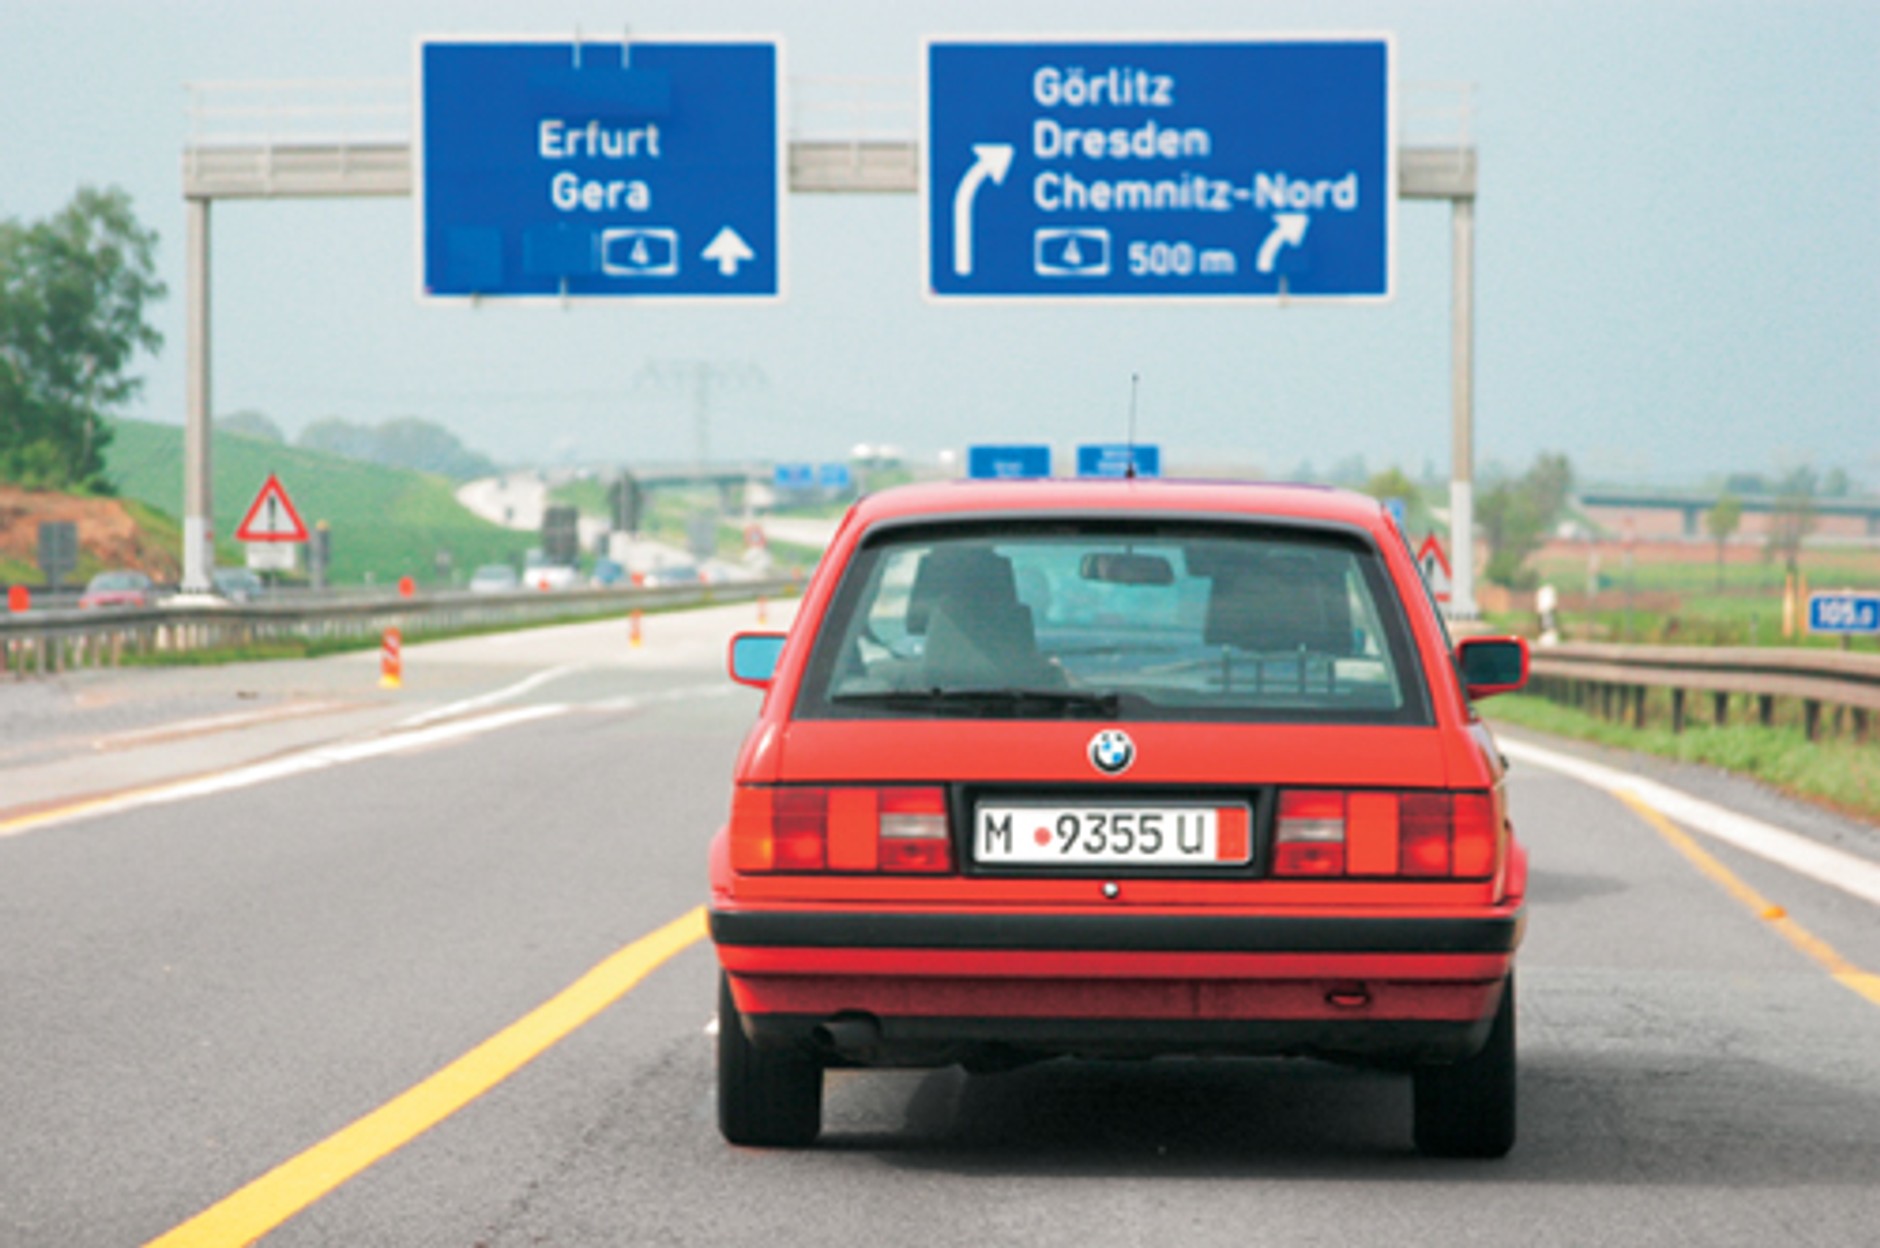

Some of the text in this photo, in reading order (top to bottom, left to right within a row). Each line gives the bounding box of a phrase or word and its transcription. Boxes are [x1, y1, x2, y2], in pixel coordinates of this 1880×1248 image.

[1033, 67, 1174, 106] Görlitz
[539, 120, 660, 158] Erfurt
[1033, 119, 1209, 158] Dresden
[551, 171, 650, 211] Gera
[1033, 171, 1357, 210] Chemnitz-Nord
[631, 236, 648, 264] 4
[1063, 237, 1082, 265] 4
[1128, 242, 1235, 275] 500 m
[985, 813, 1204, 854] M 9355 U
